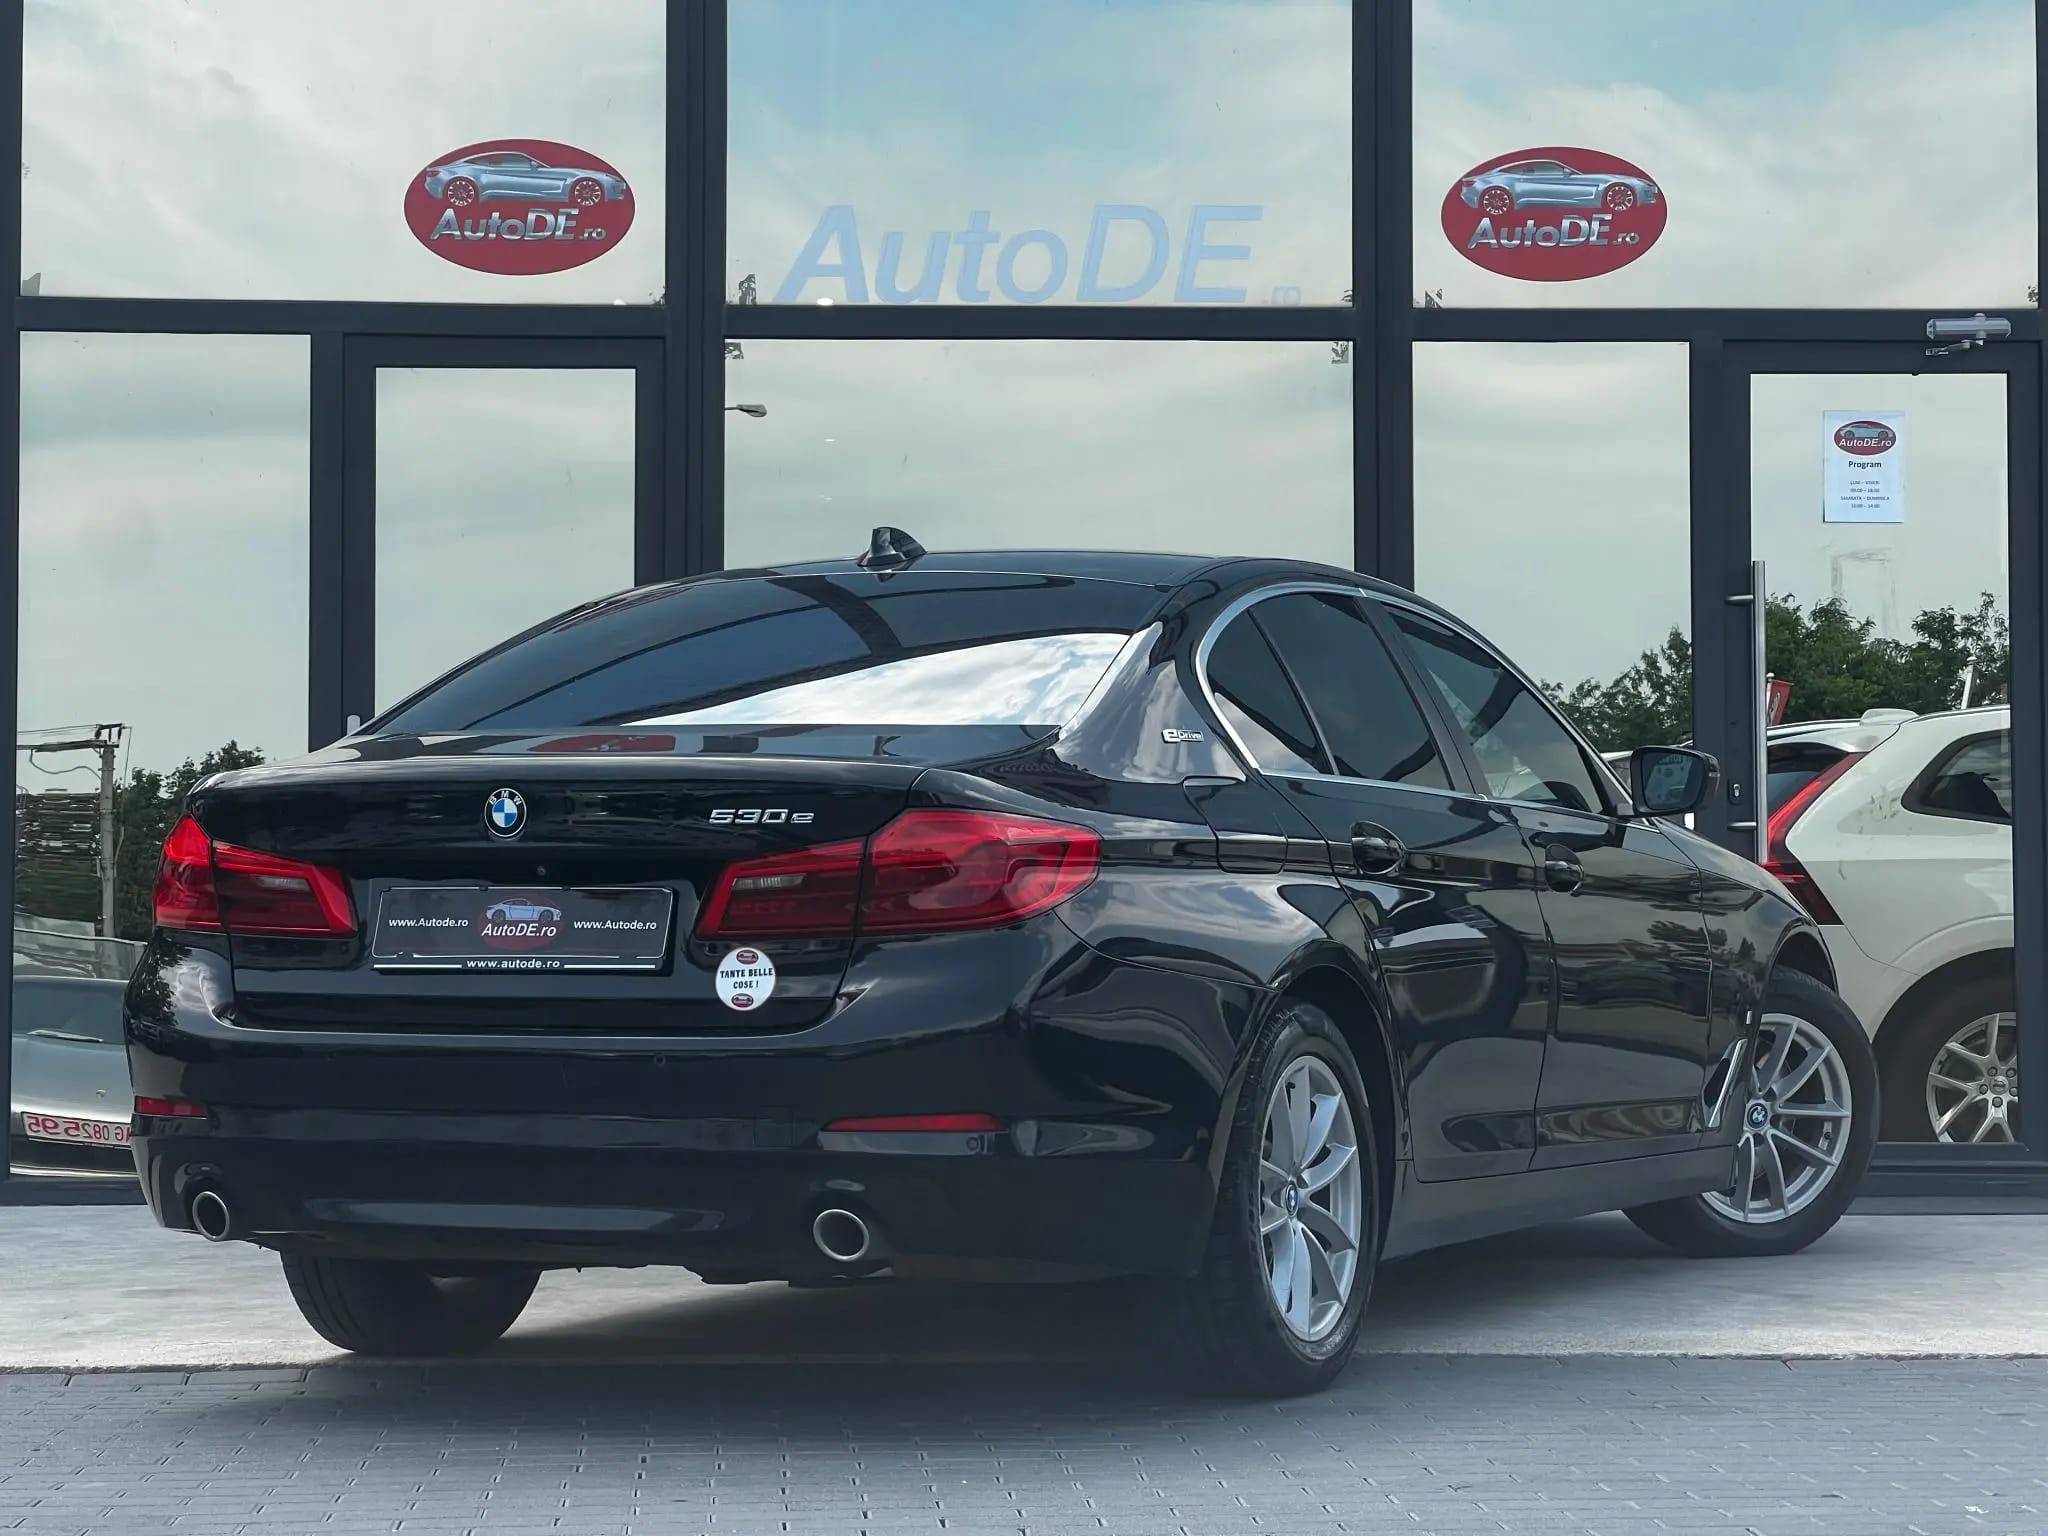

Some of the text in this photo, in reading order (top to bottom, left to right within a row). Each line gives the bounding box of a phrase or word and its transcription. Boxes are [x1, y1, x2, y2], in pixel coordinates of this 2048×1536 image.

[1838, 438, 1892, 447] AutoDE.ro
[1848, 460, 1882, 470] Program
[488, 790, 523, 806] BMW
[388, 917, 469, 928] www.Autode.ro
[573, 919, 657, 930] www.Autode.ro
[481, 922, 558, 938] AutoDE.ro
[466, 958, 561, 969] www.autode.ro
[719, 967, 774, 979] TANTE BELLE
[733, 980, 754, 990] COSE
